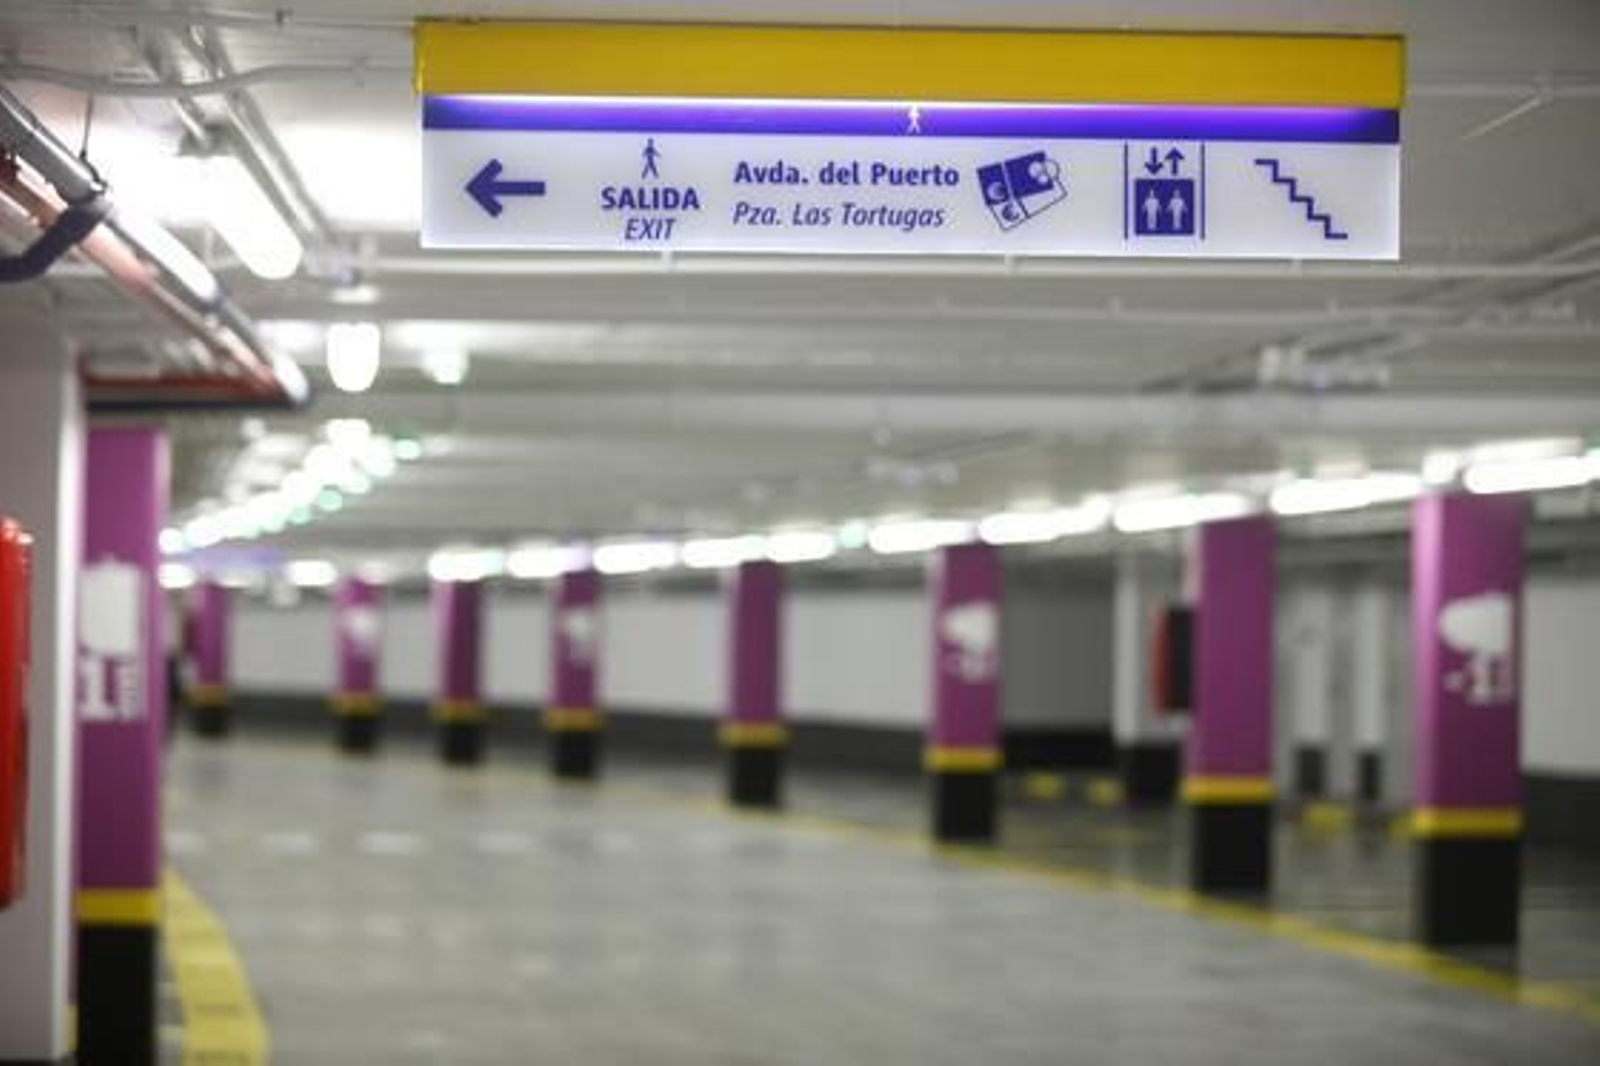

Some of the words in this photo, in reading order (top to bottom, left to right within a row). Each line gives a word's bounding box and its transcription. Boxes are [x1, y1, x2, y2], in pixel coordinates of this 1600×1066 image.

[732, 159, 809, 186] Avda.
[818, 160, 861, 186] del
[870, 161, 960, 187] Puerto
[601, 186, 701, 212] SALIDA
[624, 217, 677, 240] EXIT
[732, 201, 781, 226] Pza.
[792, 203, 832, 226] Las
[842, 202, 945, 232] Tortugas
